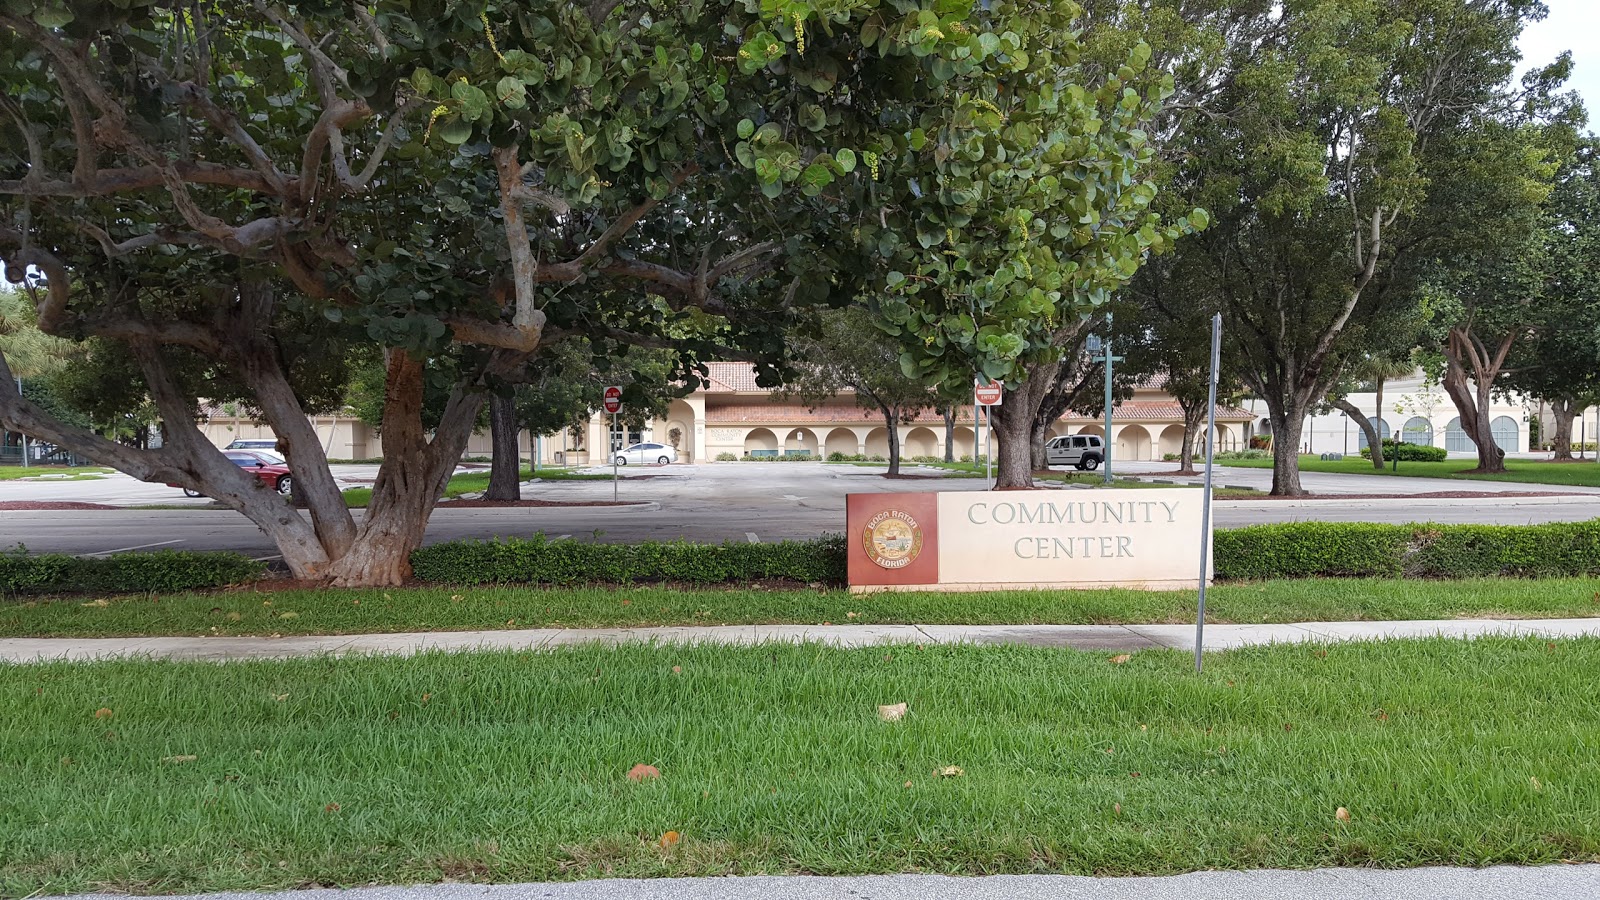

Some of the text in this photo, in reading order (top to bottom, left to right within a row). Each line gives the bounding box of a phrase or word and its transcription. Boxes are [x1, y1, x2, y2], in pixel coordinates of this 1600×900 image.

[867, 510, 918, 530] BOCA RATON
[969, 501, 1180, 525] COMMUNITY
[1014, 536, 1135, 559] CENTER
[876, 557, 911, 567] FLORIDA
